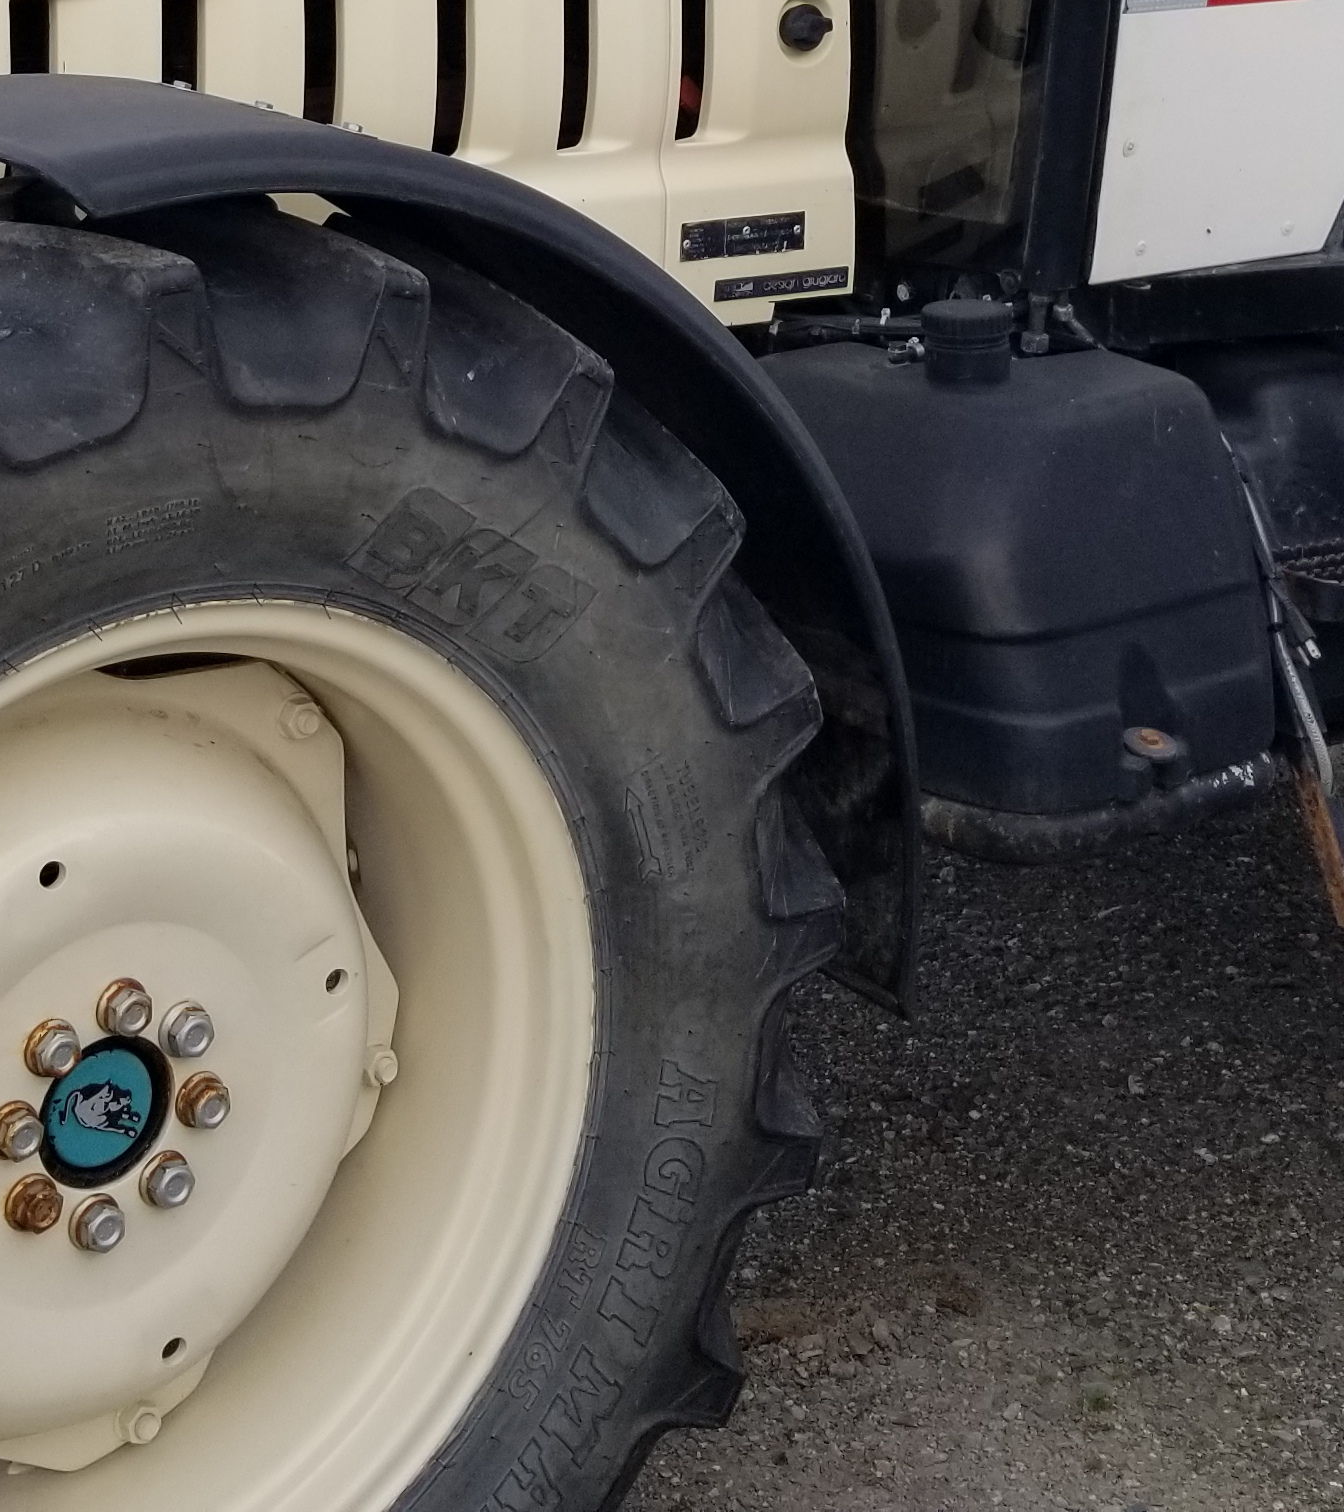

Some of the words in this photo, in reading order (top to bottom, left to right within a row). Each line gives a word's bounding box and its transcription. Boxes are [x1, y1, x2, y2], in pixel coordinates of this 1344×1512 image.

[361, 504, 581, 648] BKT
[558, 1221, 608, 1311] RT
[596, 1058, 719, 1348] AGRI
[480, 1344, 624, 1512] MA
[507, 1307, 571, 1413] 765
